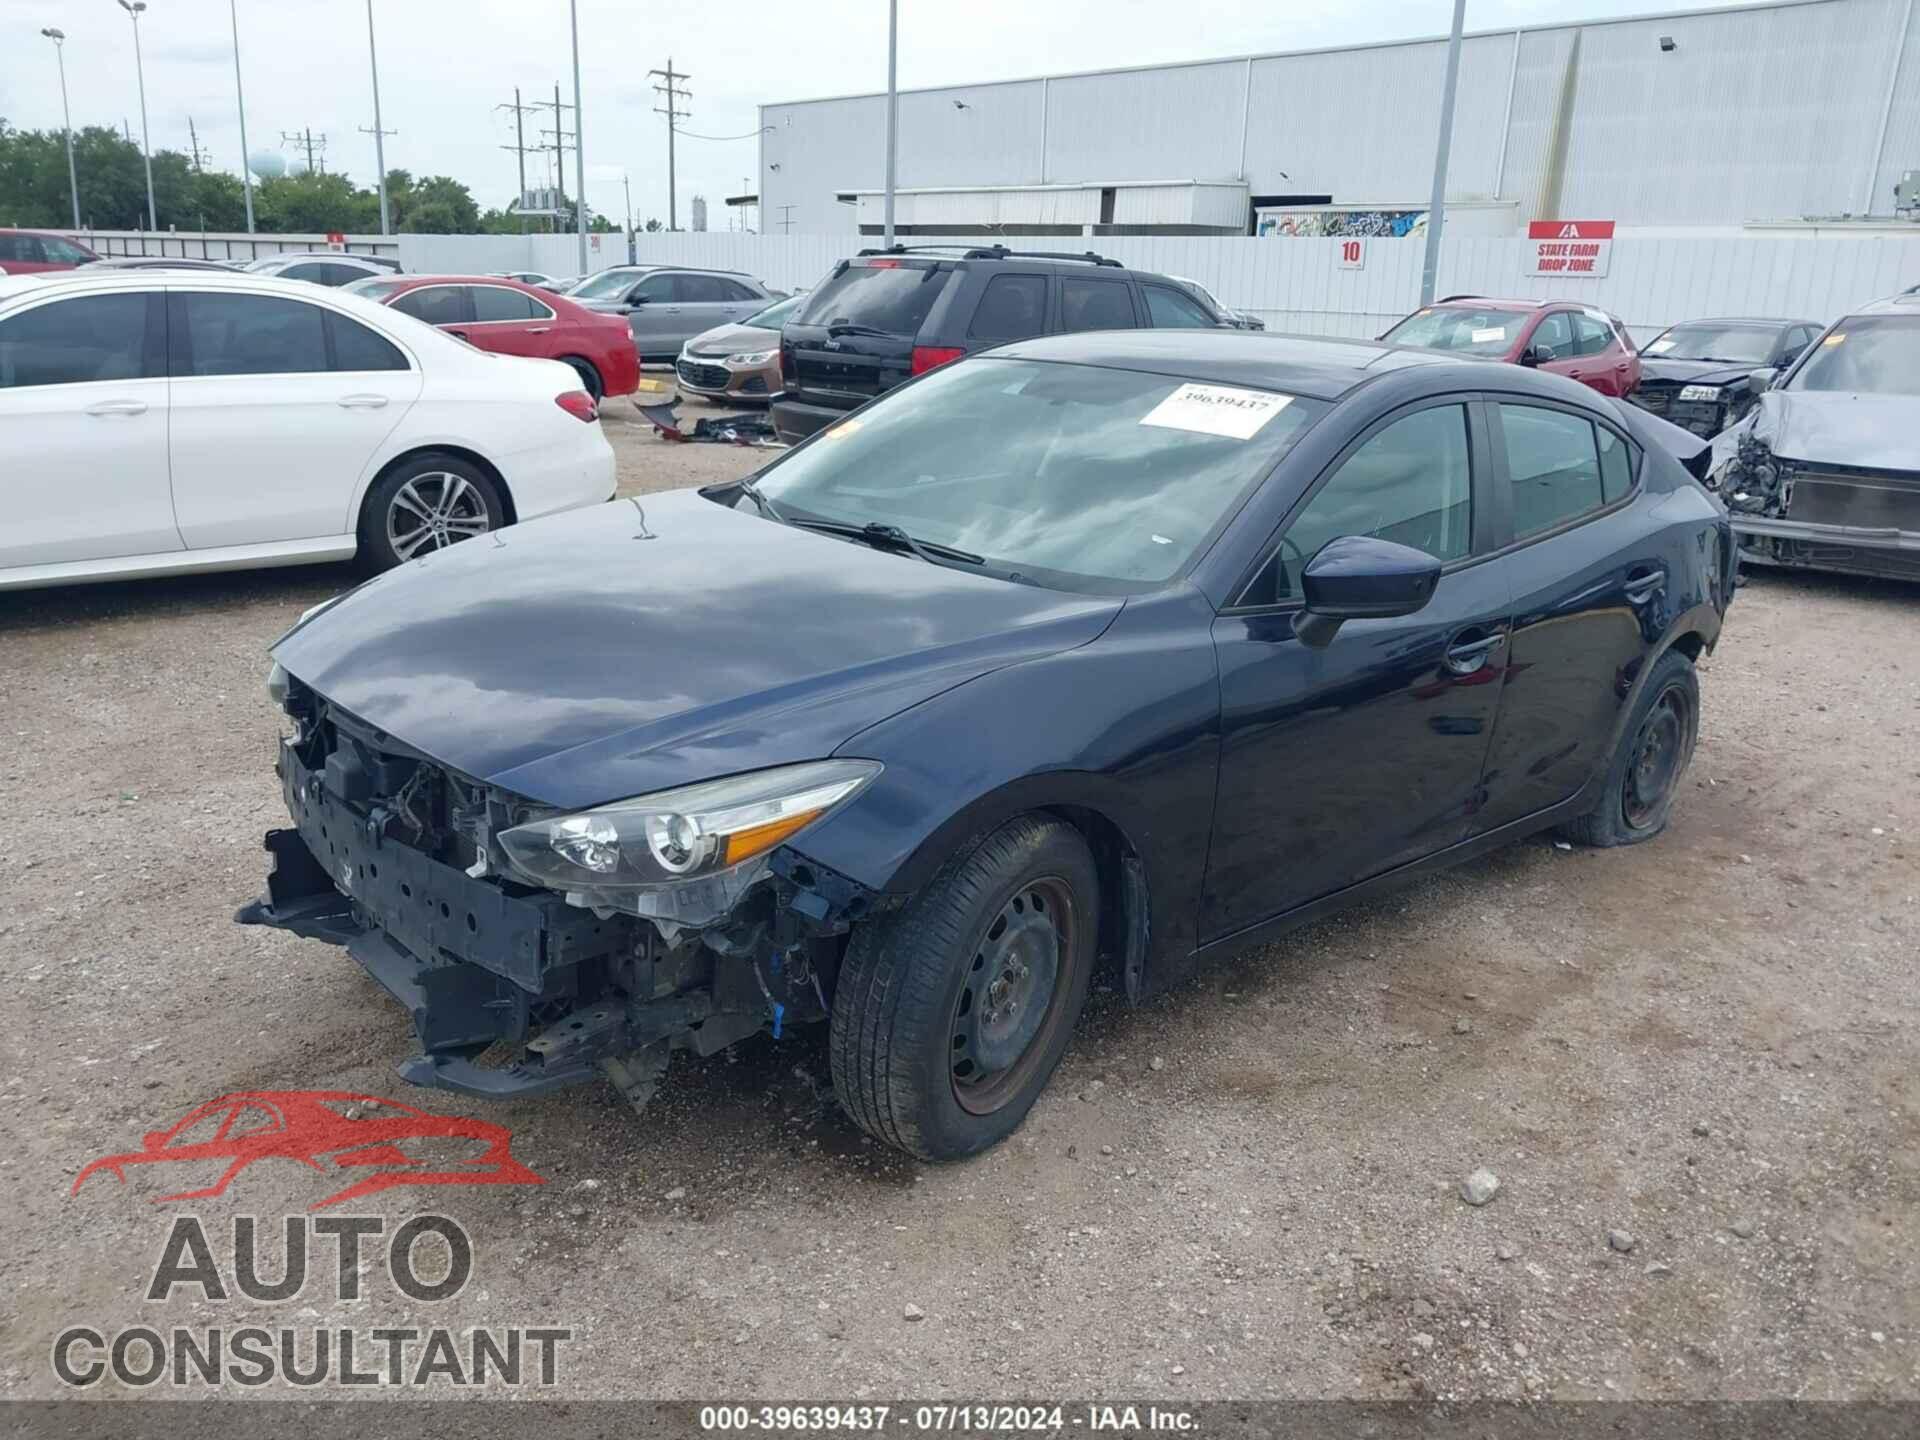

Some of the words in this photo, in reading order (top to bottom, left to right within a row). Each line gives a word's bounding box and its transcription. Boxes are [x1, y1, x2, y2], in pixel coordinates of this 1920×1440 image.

[1342, 241, 1361, 262] 10
[1538, 244, 1569, 256] STATE
[1569, 244, 1599, 256] FARM
[1538, 259, 1567, 271] DROP
[1567, 259, 1595, 271] ZONE
[824, 340, 841, 351] Jeep
